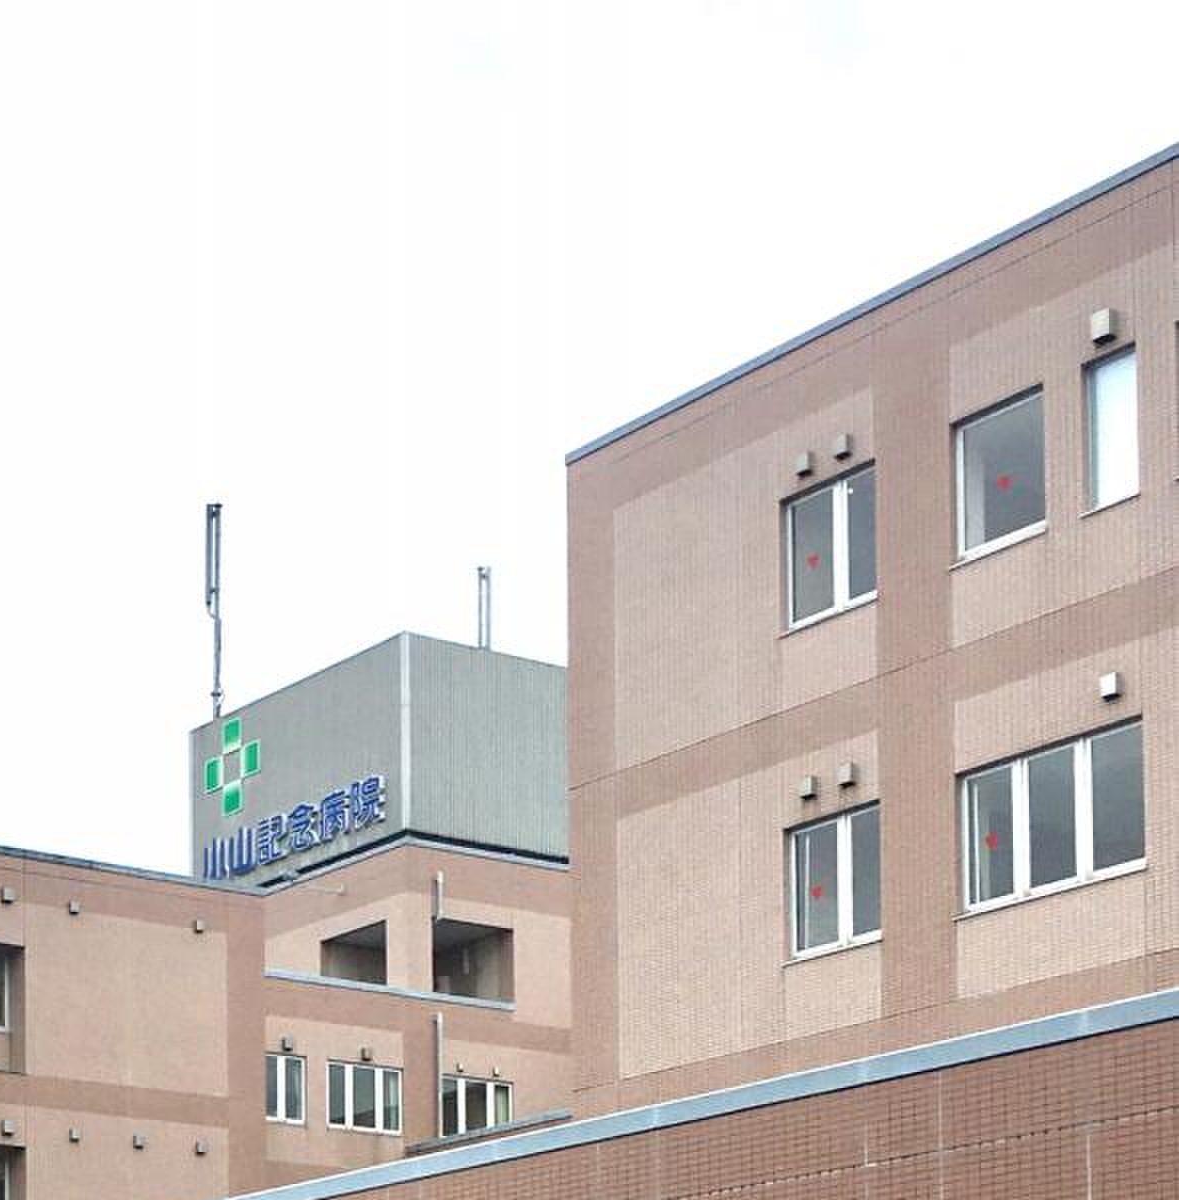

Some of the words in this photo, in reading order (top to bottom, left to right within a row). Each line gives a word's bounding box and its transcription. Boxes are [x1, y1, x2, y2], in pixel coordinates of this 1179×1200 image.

[203, 775, 387, 879] 小山記念病院
